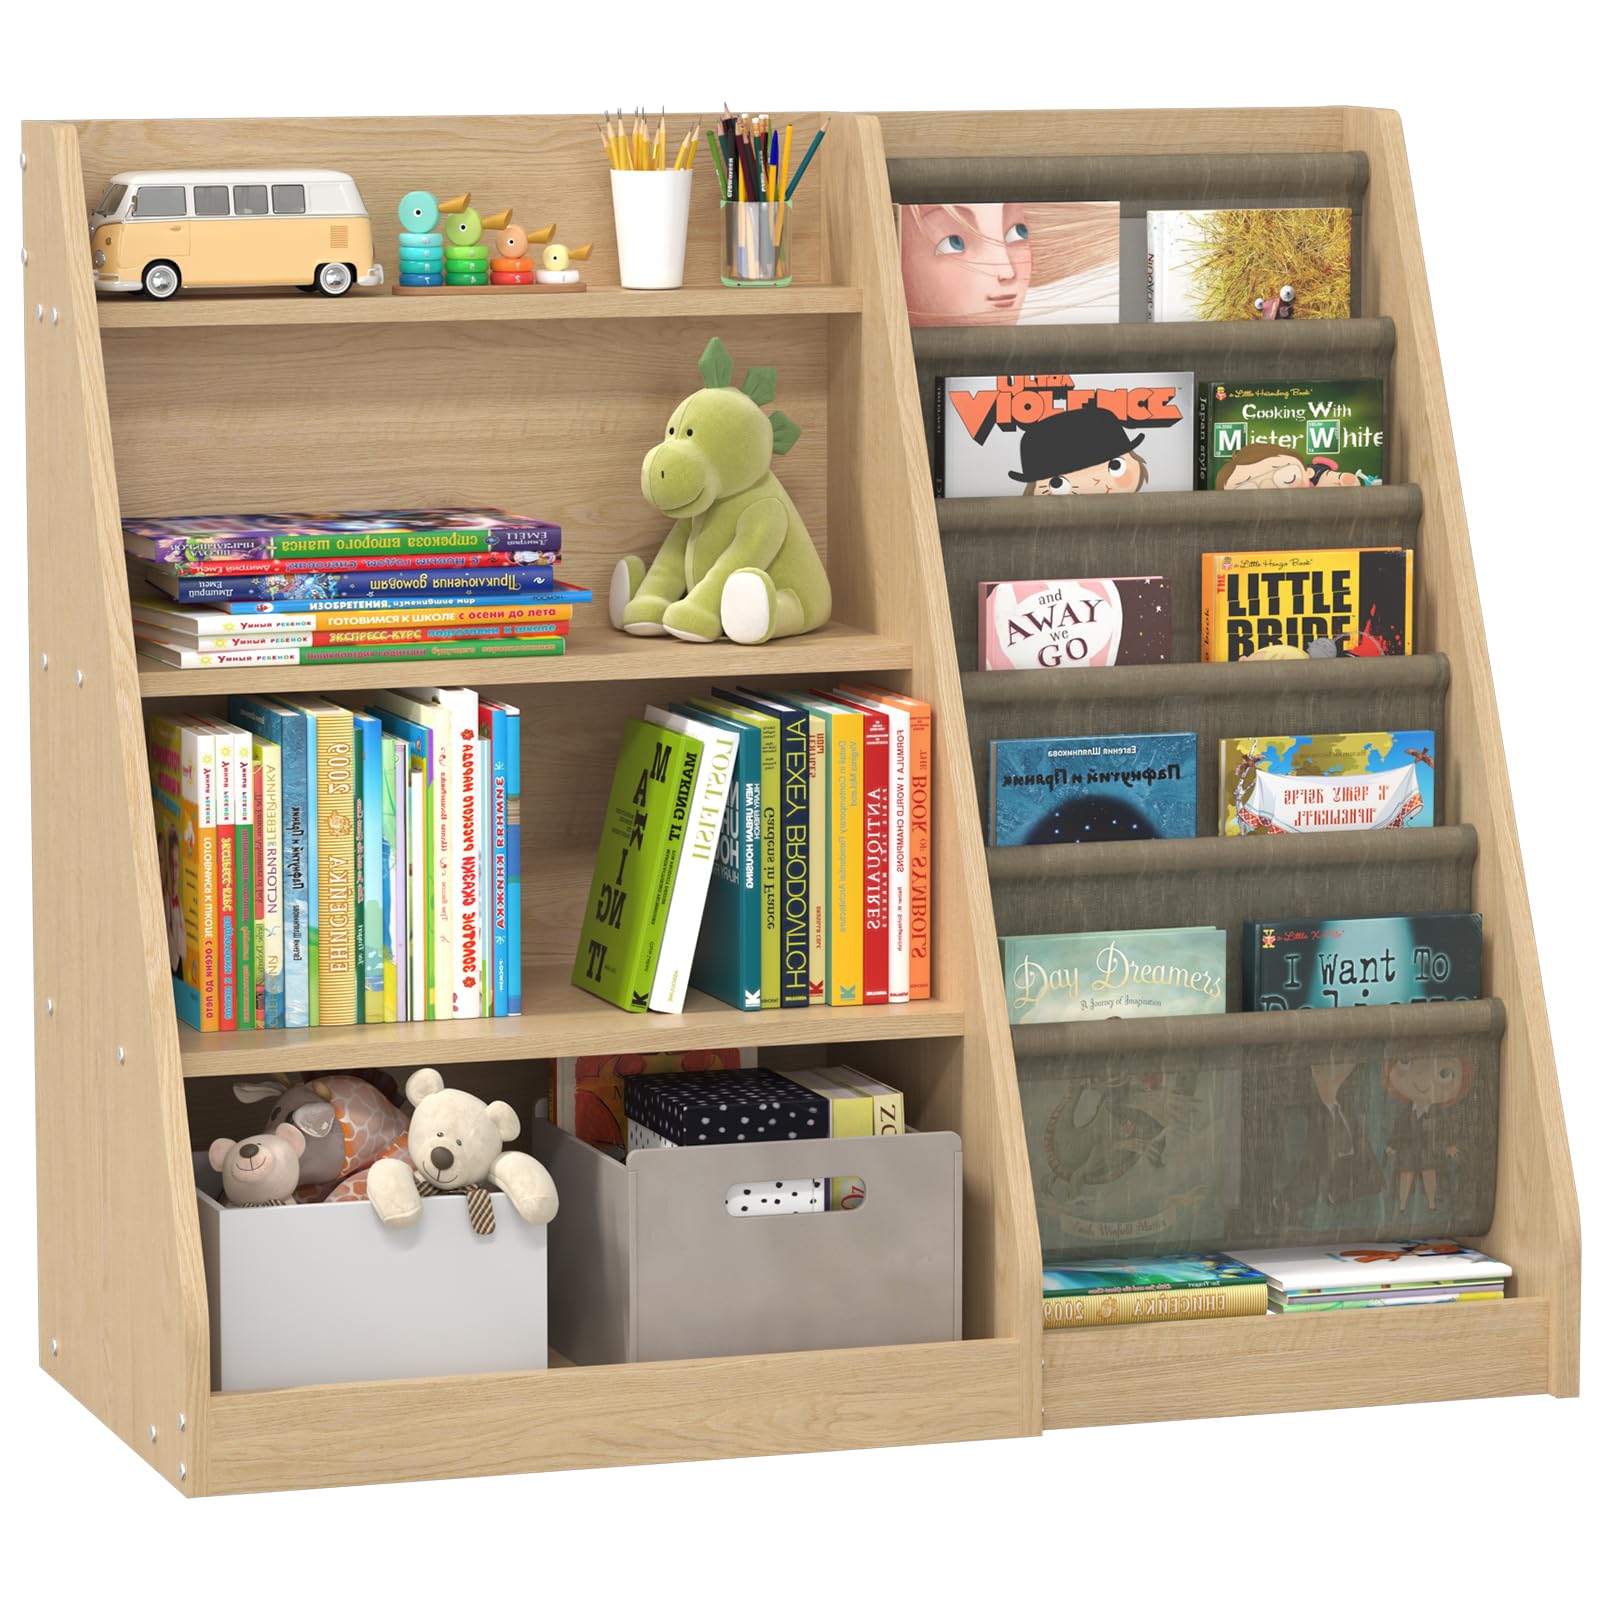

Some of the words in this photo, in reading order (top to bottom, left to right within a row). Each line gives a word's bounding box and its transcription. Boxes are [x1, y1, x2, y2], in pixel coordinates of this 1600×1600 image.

[950, 387, 1183, 440] VIOLENCE
[1199, 396, 1208, 441] Japan
[1242, 403, 1307, 421] Cooking
[1308, 401, 1352, 419] With
[282, 540, 330, 552] шанса
[336, 535, 401, 550] второго
[408, 533, 478, 549] стрекоза
[416, 557, 465, 568] Новым
[199, 580, 223, 589] Емец
[370, 574, 428, 590] домовят
[432, 573, 521, 590] Приключения
[1217, 573, 1226, 594] THE
[188, 589, 233, 598] Дмитрий
[1038, 588, 1063, 605] and
[1227, 570, 1352, 617] LITTLE
[309, 600, 391, 611] ИЗОБРЕТЕНИЯ,
[328, 615, 399, 626] ГОТОВИМСЯ
[401, 615, 410, 623] К
[412, 613, 455, 623] ШКОЛЕ
[468, 610, 505, 619] осени
[508, 610, 524, 619] до
[528, 608, 556, 617] лета
[1007, 599, 1104, 647] AWAY
[328, 630, 422, 643] ЭКСПРЕСС-КУРС
[1049, 629, 1069, 642] we
[1227, 615, 1352, 662] BRIDE
[1037, 637, 1088, 667] GO
[1013, 955, 1079, 1009] Day
[1091, 940, 1221, 1000] Dreamers
[1284, 954, 1300, 988] I
[1318, 948, 1396, 985] Want
[1413, 948, 1449, 982] To
